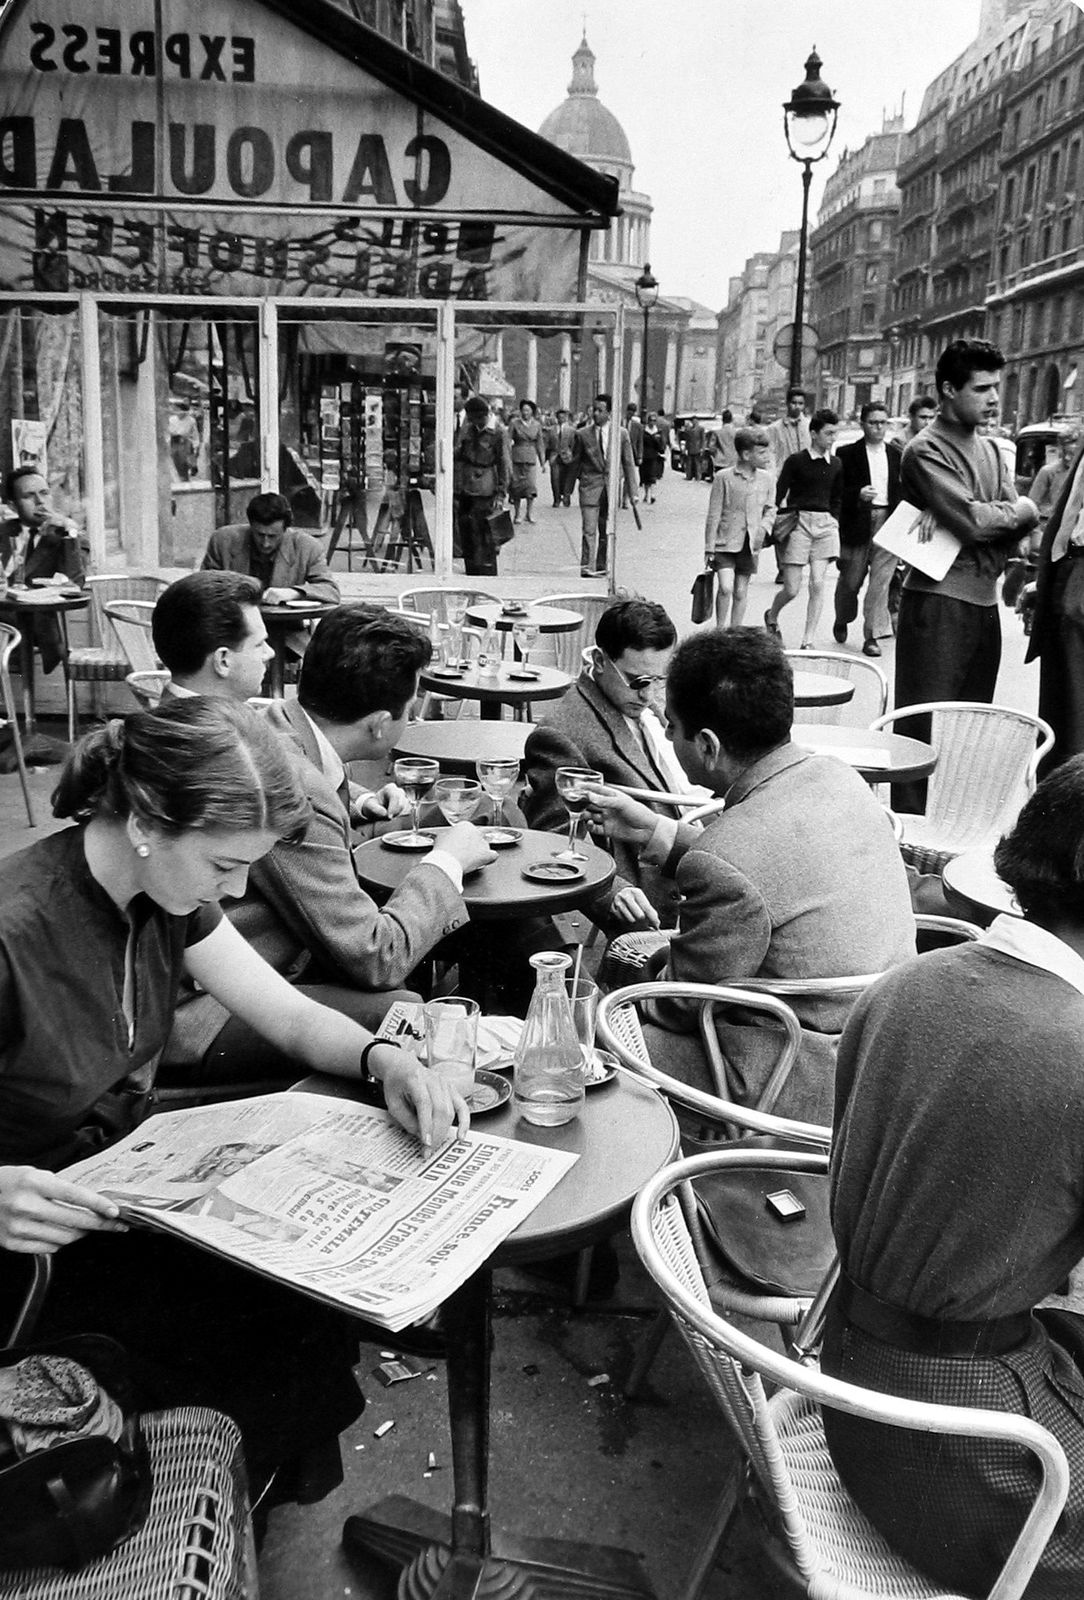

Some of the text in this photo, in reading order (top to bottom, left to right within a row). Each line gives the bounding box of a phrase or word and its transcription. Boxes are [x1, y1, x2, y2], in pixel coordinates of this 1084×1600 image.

[450, 1144, 501, 1187] Entrevue
[299, 1208, 315, 1223] du
[319, 1197, 391, 1254] GUATEMALA
[425, 1194, 518, 1267] France-soir
